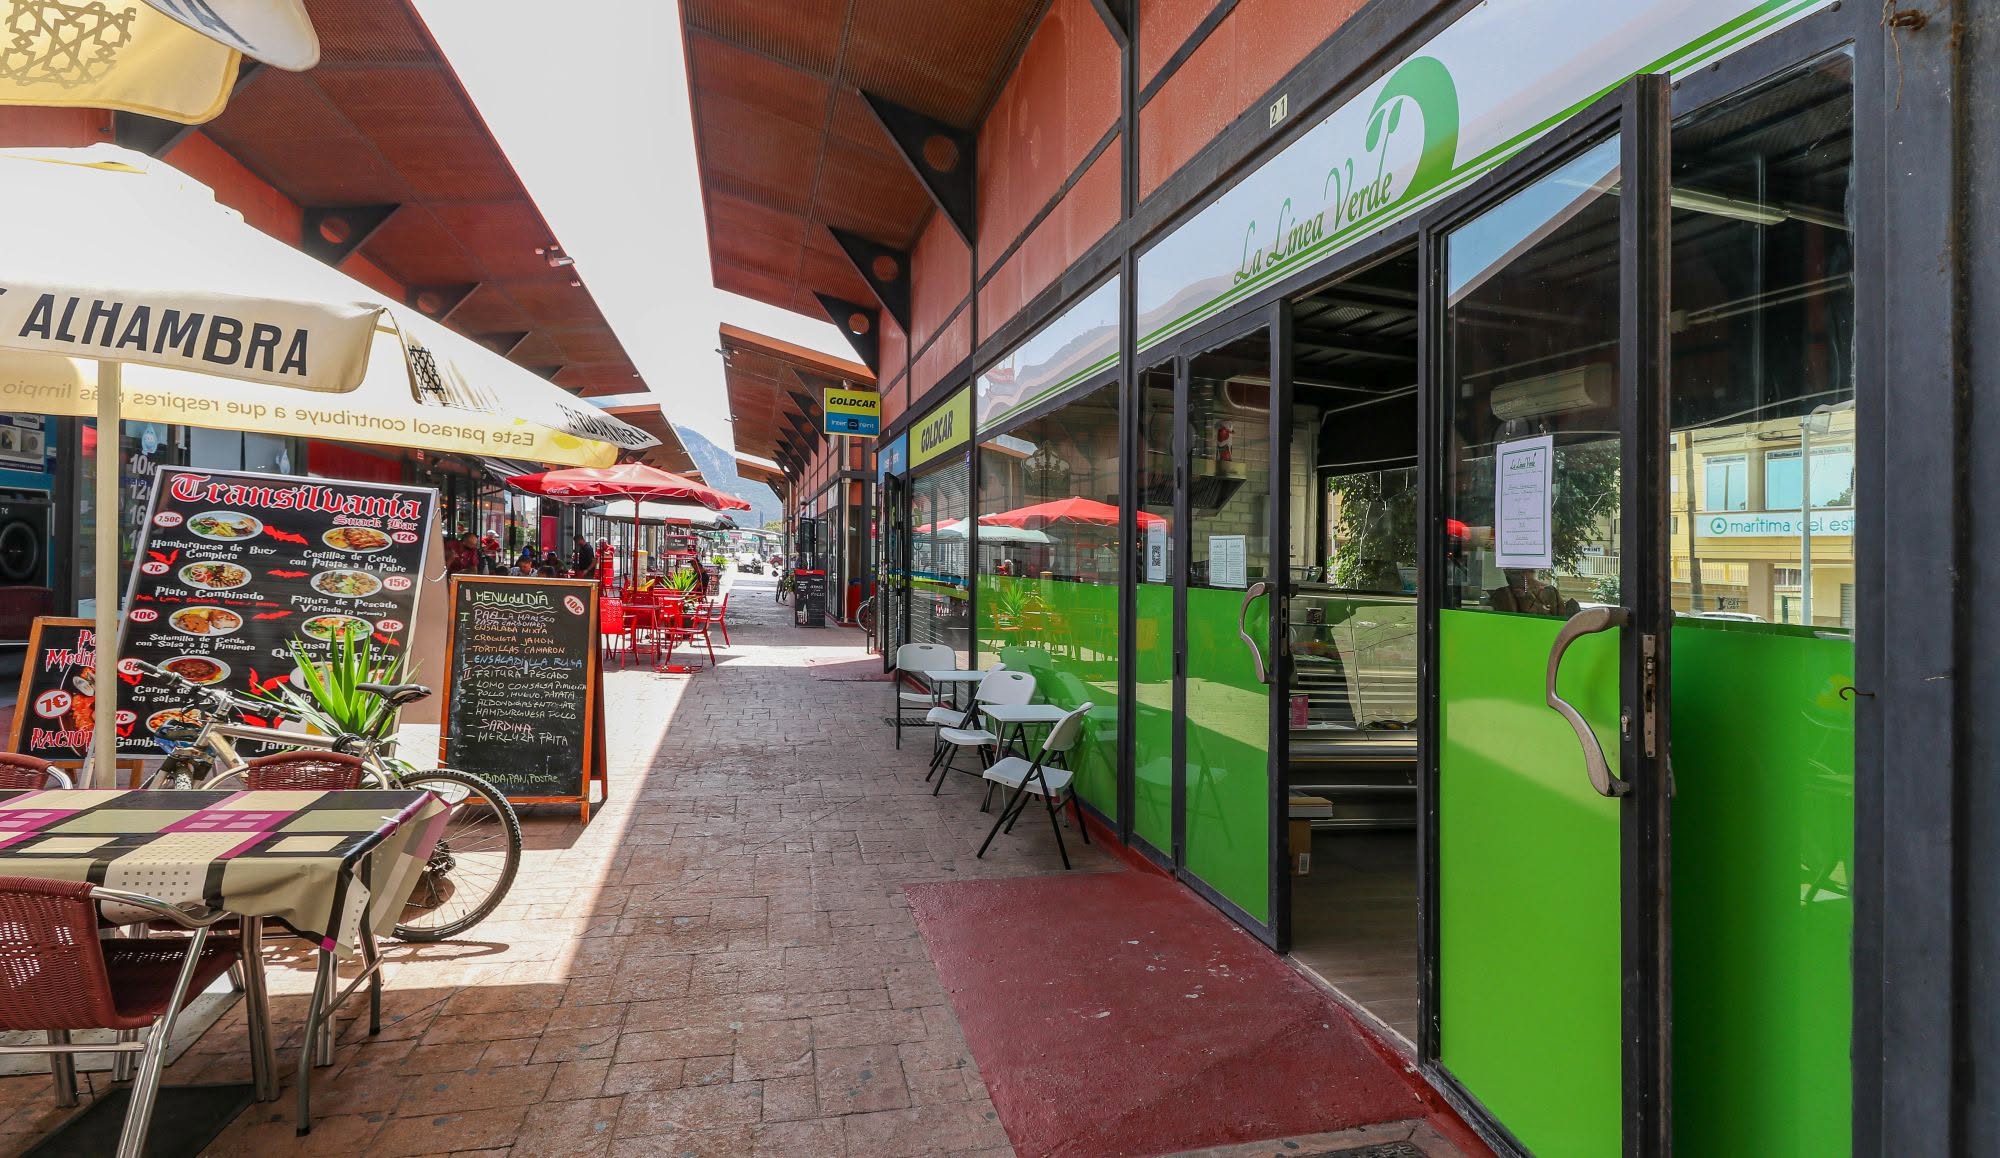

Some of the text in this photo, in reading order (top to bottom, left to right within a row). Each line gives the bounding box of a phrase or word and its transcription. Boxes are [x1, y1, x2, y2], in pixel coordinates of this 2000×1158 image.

[1271, 97, 1287, 125] 21
[1233, 150, 1393, 286] La Línea Verde
[18, 293, 309, 376] ALHAMBRA
[829, 397, 877, 409] GOLDCAR
[858, 421, 875, 429] rent
[920, 409, 954, 454] GOLDCAR
[171, 472, 422, 520] Transilvania
[332, 514, 419, 531] Snack Bar
[395, 533, 416, 541] 12€
[150, 539, 277, 555] Hamburguesa de Buey
[185, 549, 238, 561] Completa
[302, 549, 397, 564] Costillas de Cerdo
[149, 564, 162, 572] 7€
[311, 558, 348, 569] Patatas
[378, 563, 407, 574] Pobre
[388, 578, 409, 588] 15€
[155, 585, 188, 598] Plato
[194, 589, 265, 601] Combinado
[475, 590, 508, 603] MENU
[508, 592, 525, 605] del
[290, 594, 329, 606] Fritura
[335, 598, 348, 606] de
[354, 598, 398, 609] Pescado
[565, 596, 583, 615] 10€
[300, 604, 342, 613] Variada
[133, 611, 155, 619] 10€
[382, 622, 398, 630] 8€
[474, 623, 518, 633] ENSALADA
[149, 633, 245, 645] Solomillo de Cerdo
[157, 640, 184, 648] Salsa
[214, 642, 256, 651] Pimienta
[472, 645, 566, 654] TORTILLAS CAMARON
[553, 658, 583, 668] RUSA
[474, 669, 522, 679] FRITURA
[529, 669, 569, 680] PESCADO
[134, 685, 191, 695] Carne de
[476, 680, 505, 690] LOMO
[543, 690, 575, 700] PATATA
[39, 694, 68, 713] 7€
[475, 707, 545, 718] HAMBURGUESA
[478, 718, 533, 733] SARDINA
[477, 731, 568, 746] MERLUZA FRITA
